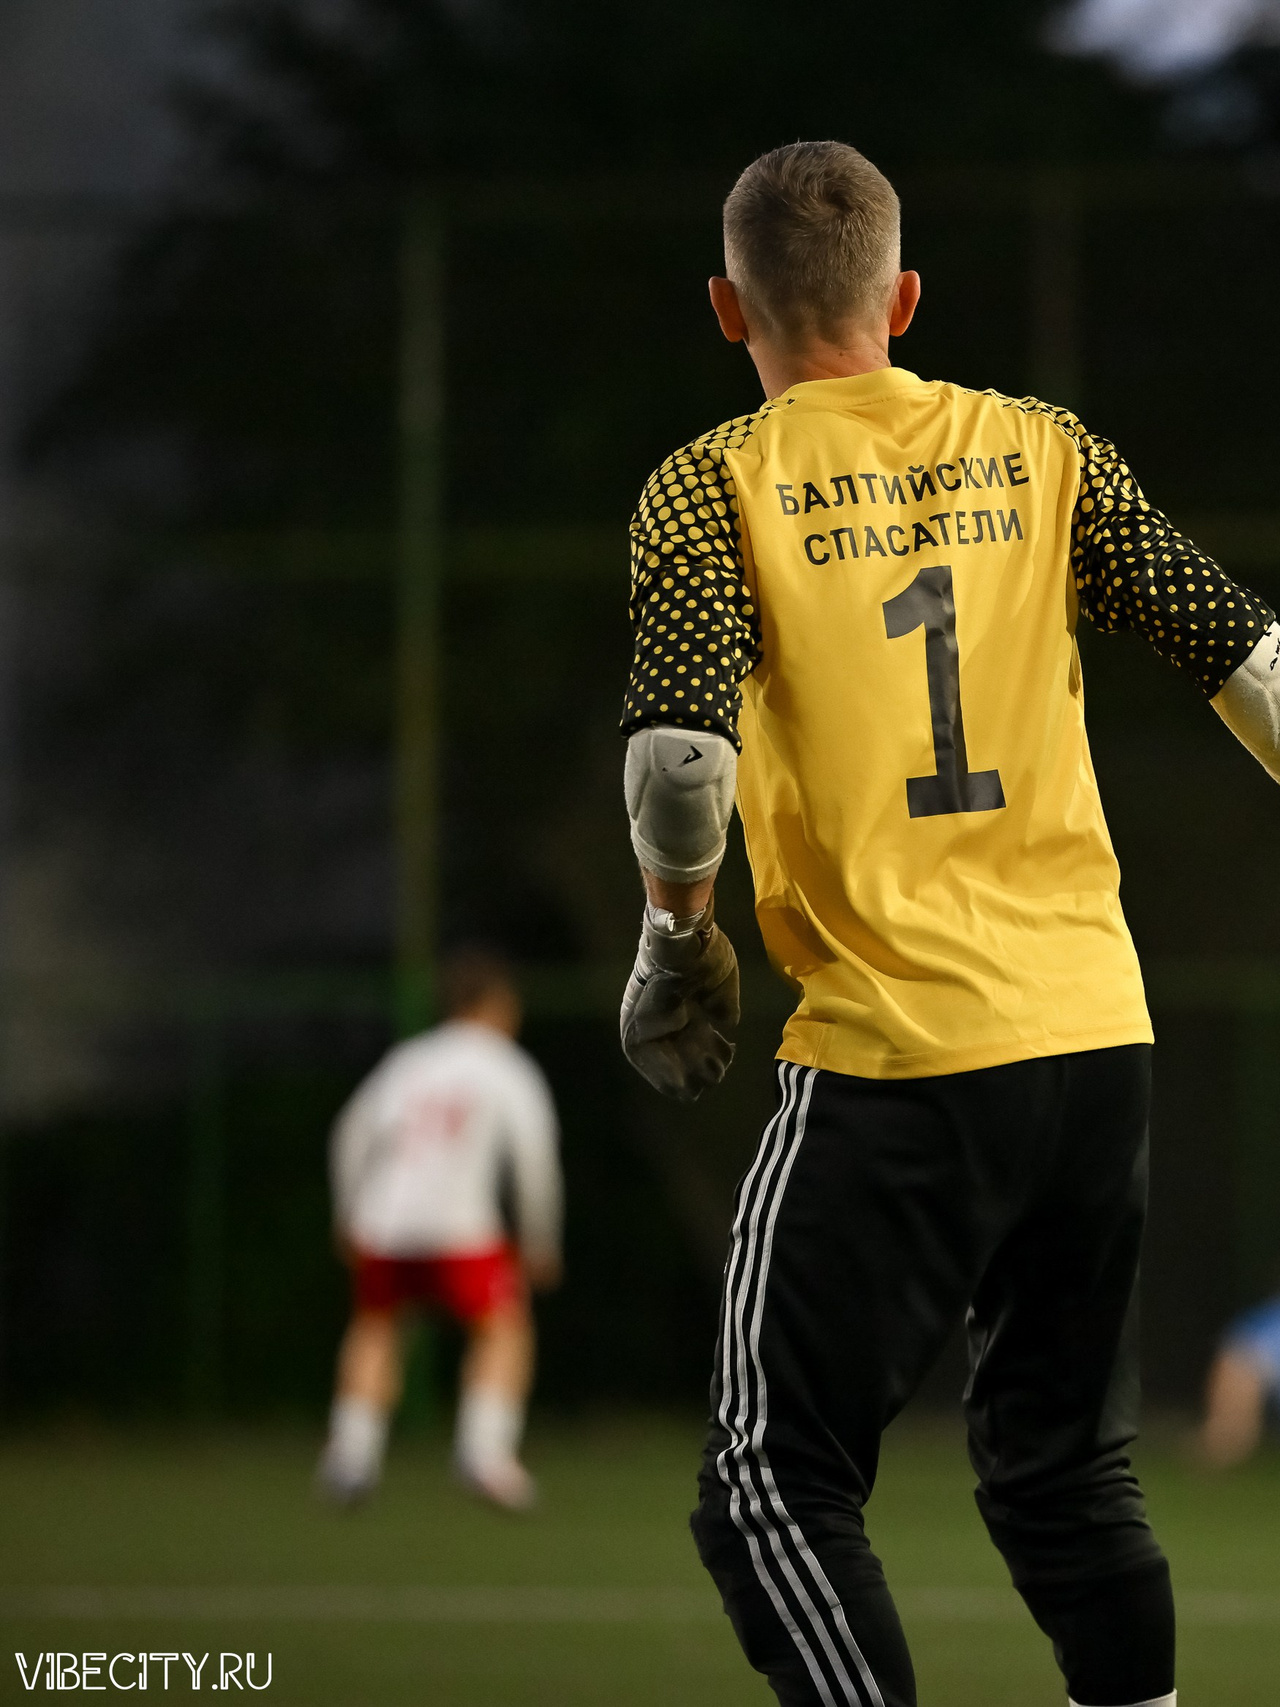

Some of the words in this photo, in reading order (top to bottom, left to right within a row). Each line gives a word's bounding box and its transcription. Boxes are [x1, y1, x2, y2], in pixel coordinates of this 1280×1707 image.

[775, 452, 1030, 516] БАЛТИЙСКИЕ
[803, 508, 1024, 566] СПАСАТЕЛИ
[881, 564, 1007, 819] 1
